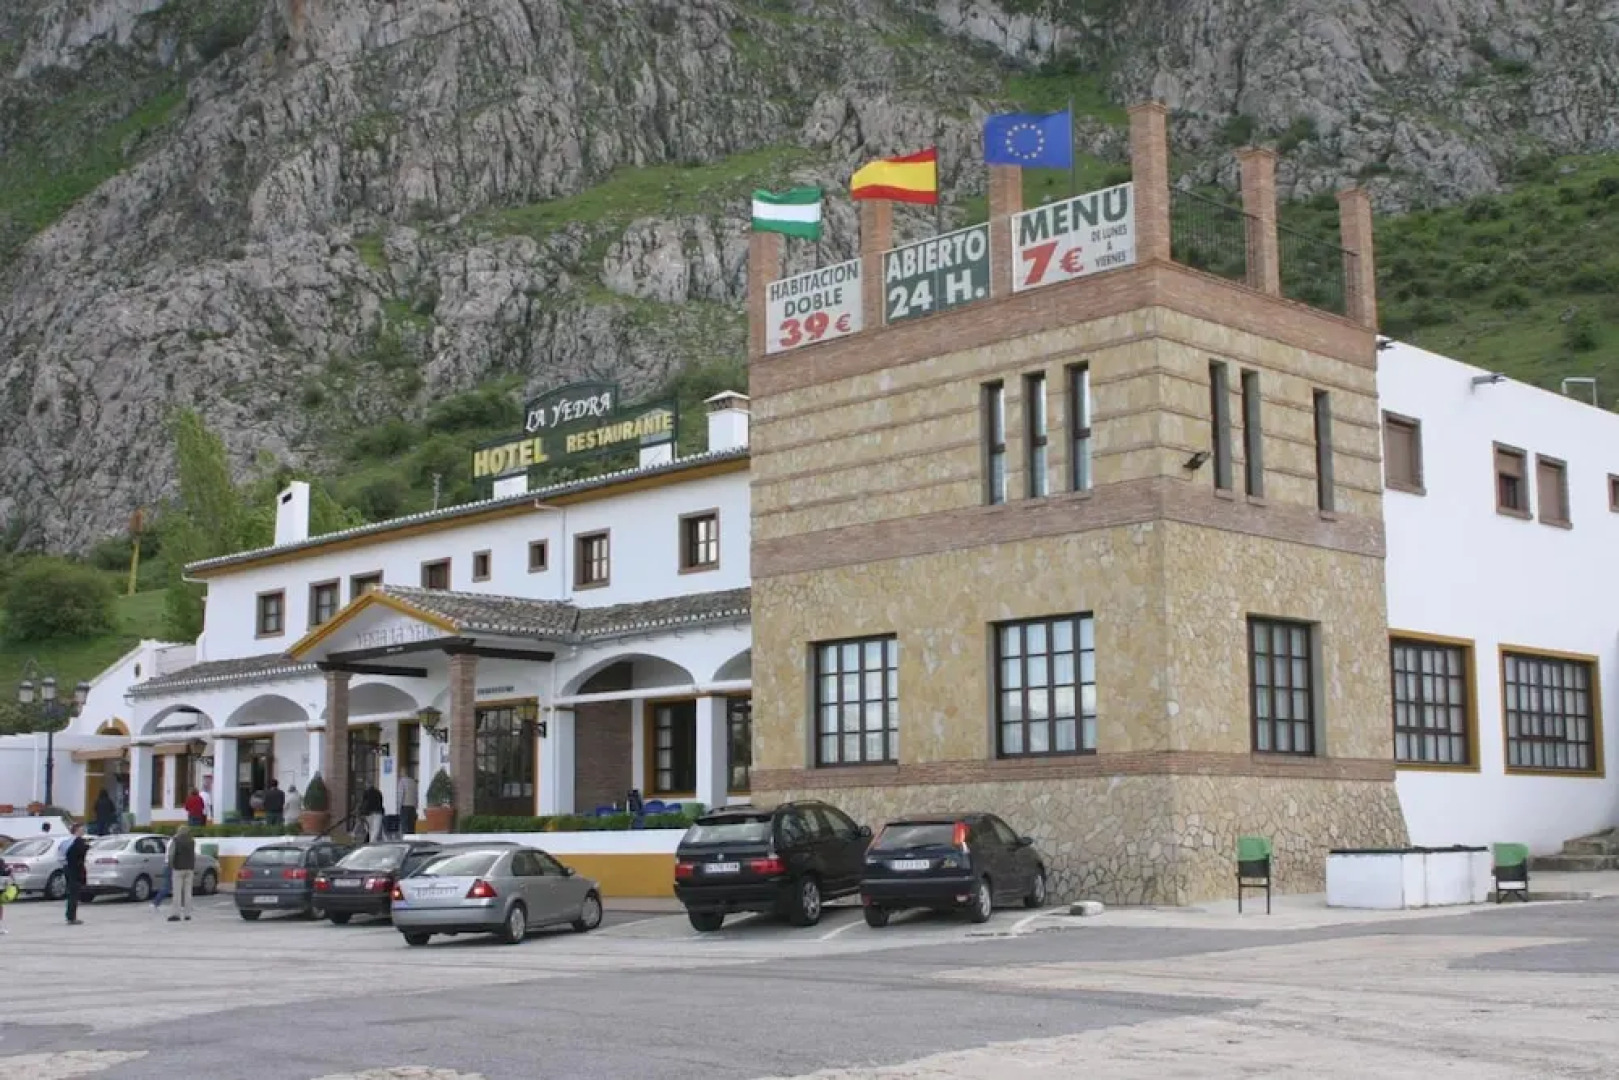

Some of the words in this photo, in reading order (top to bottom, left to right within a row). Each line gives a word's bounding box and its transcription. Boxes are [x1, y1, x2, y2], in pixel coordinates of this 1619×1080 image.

[1102, 224, 1127, 239] LUNES
[887, 229, 986, 283] ABIERTO
[1022, 240, 1058, 285] 7
[1059, 247, 1084, 273] €
[1094, 251, 1126, 267] VIERNES
[771, 261, 858, 301] HABITACION
[888, 280, 933, 319] 24
[946, 269, 985, 304] H.
[785, 287, 842, 317] DOBLE
[779, 311, 829, 347] 39
[835, 313, 851, 332] €
[525, 409, 546, 432] LA
[550, 392, 611, 428] YEDRA
[566, 410, 674, 453] RESTAURANTE
[473, 437, 549, 478] HOTEL
